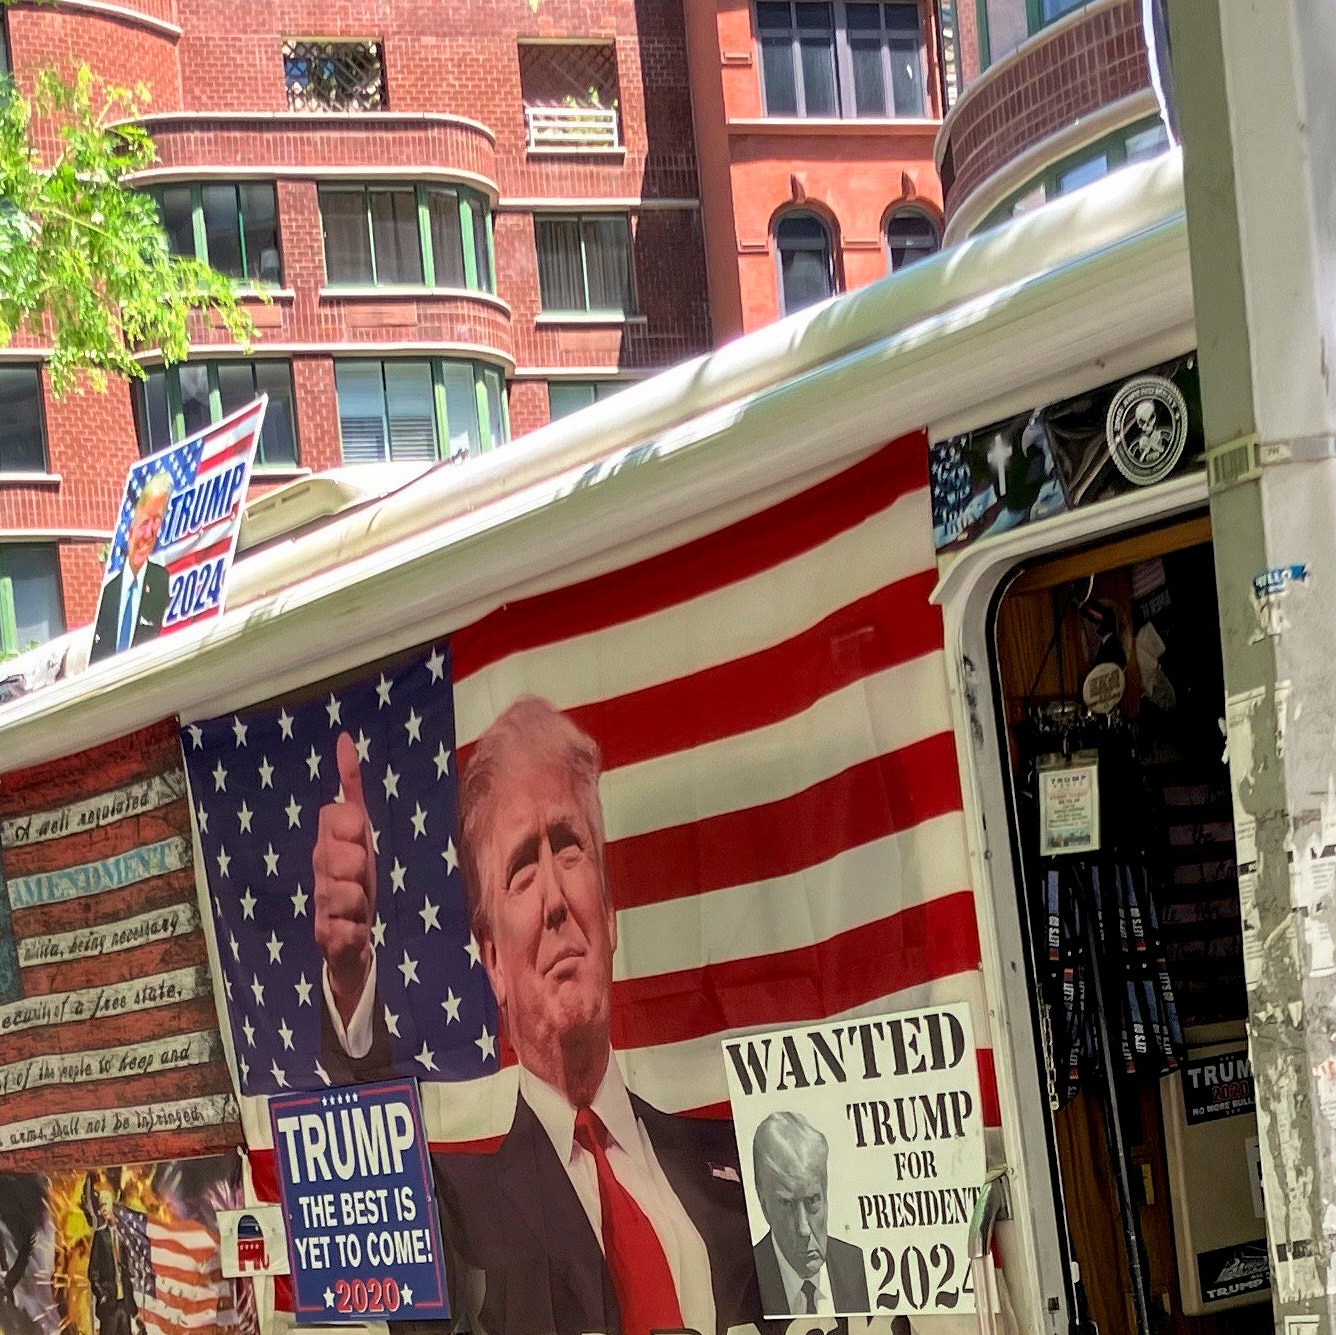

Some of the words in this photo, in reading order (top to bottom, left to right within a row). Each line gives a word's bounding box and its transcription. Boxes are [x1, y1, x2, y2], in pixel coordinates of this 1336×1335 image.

[162, 462, 247, 547] TRUMP
[166, 557, 226, 623] 2024
[80, 789, 150, 829] regulated
[110, 914, 180, 948] necessary
[160, 1041, 192, 1065] and
[725, 1011, 966, 1096] WANTED
[846, 1090, 973, 1148] TRUMP
[277, 1101, 415, 1184] TRUMP
[894, 1150, 938, 1181] FOR
[298, 1195, 338, 1229] THE
[340, 1189, 389, 1225] BEST
[393, 1186, 416, 1222] IS
[858, 1186, 981, 1230] PRESIDENT
[295, 1236, 331, 1270] YET
[335, 1233, 361, 1268] TO
[367, 1229, 433, 1267] COME!
[335, 1277, 400, 1314] 2020
